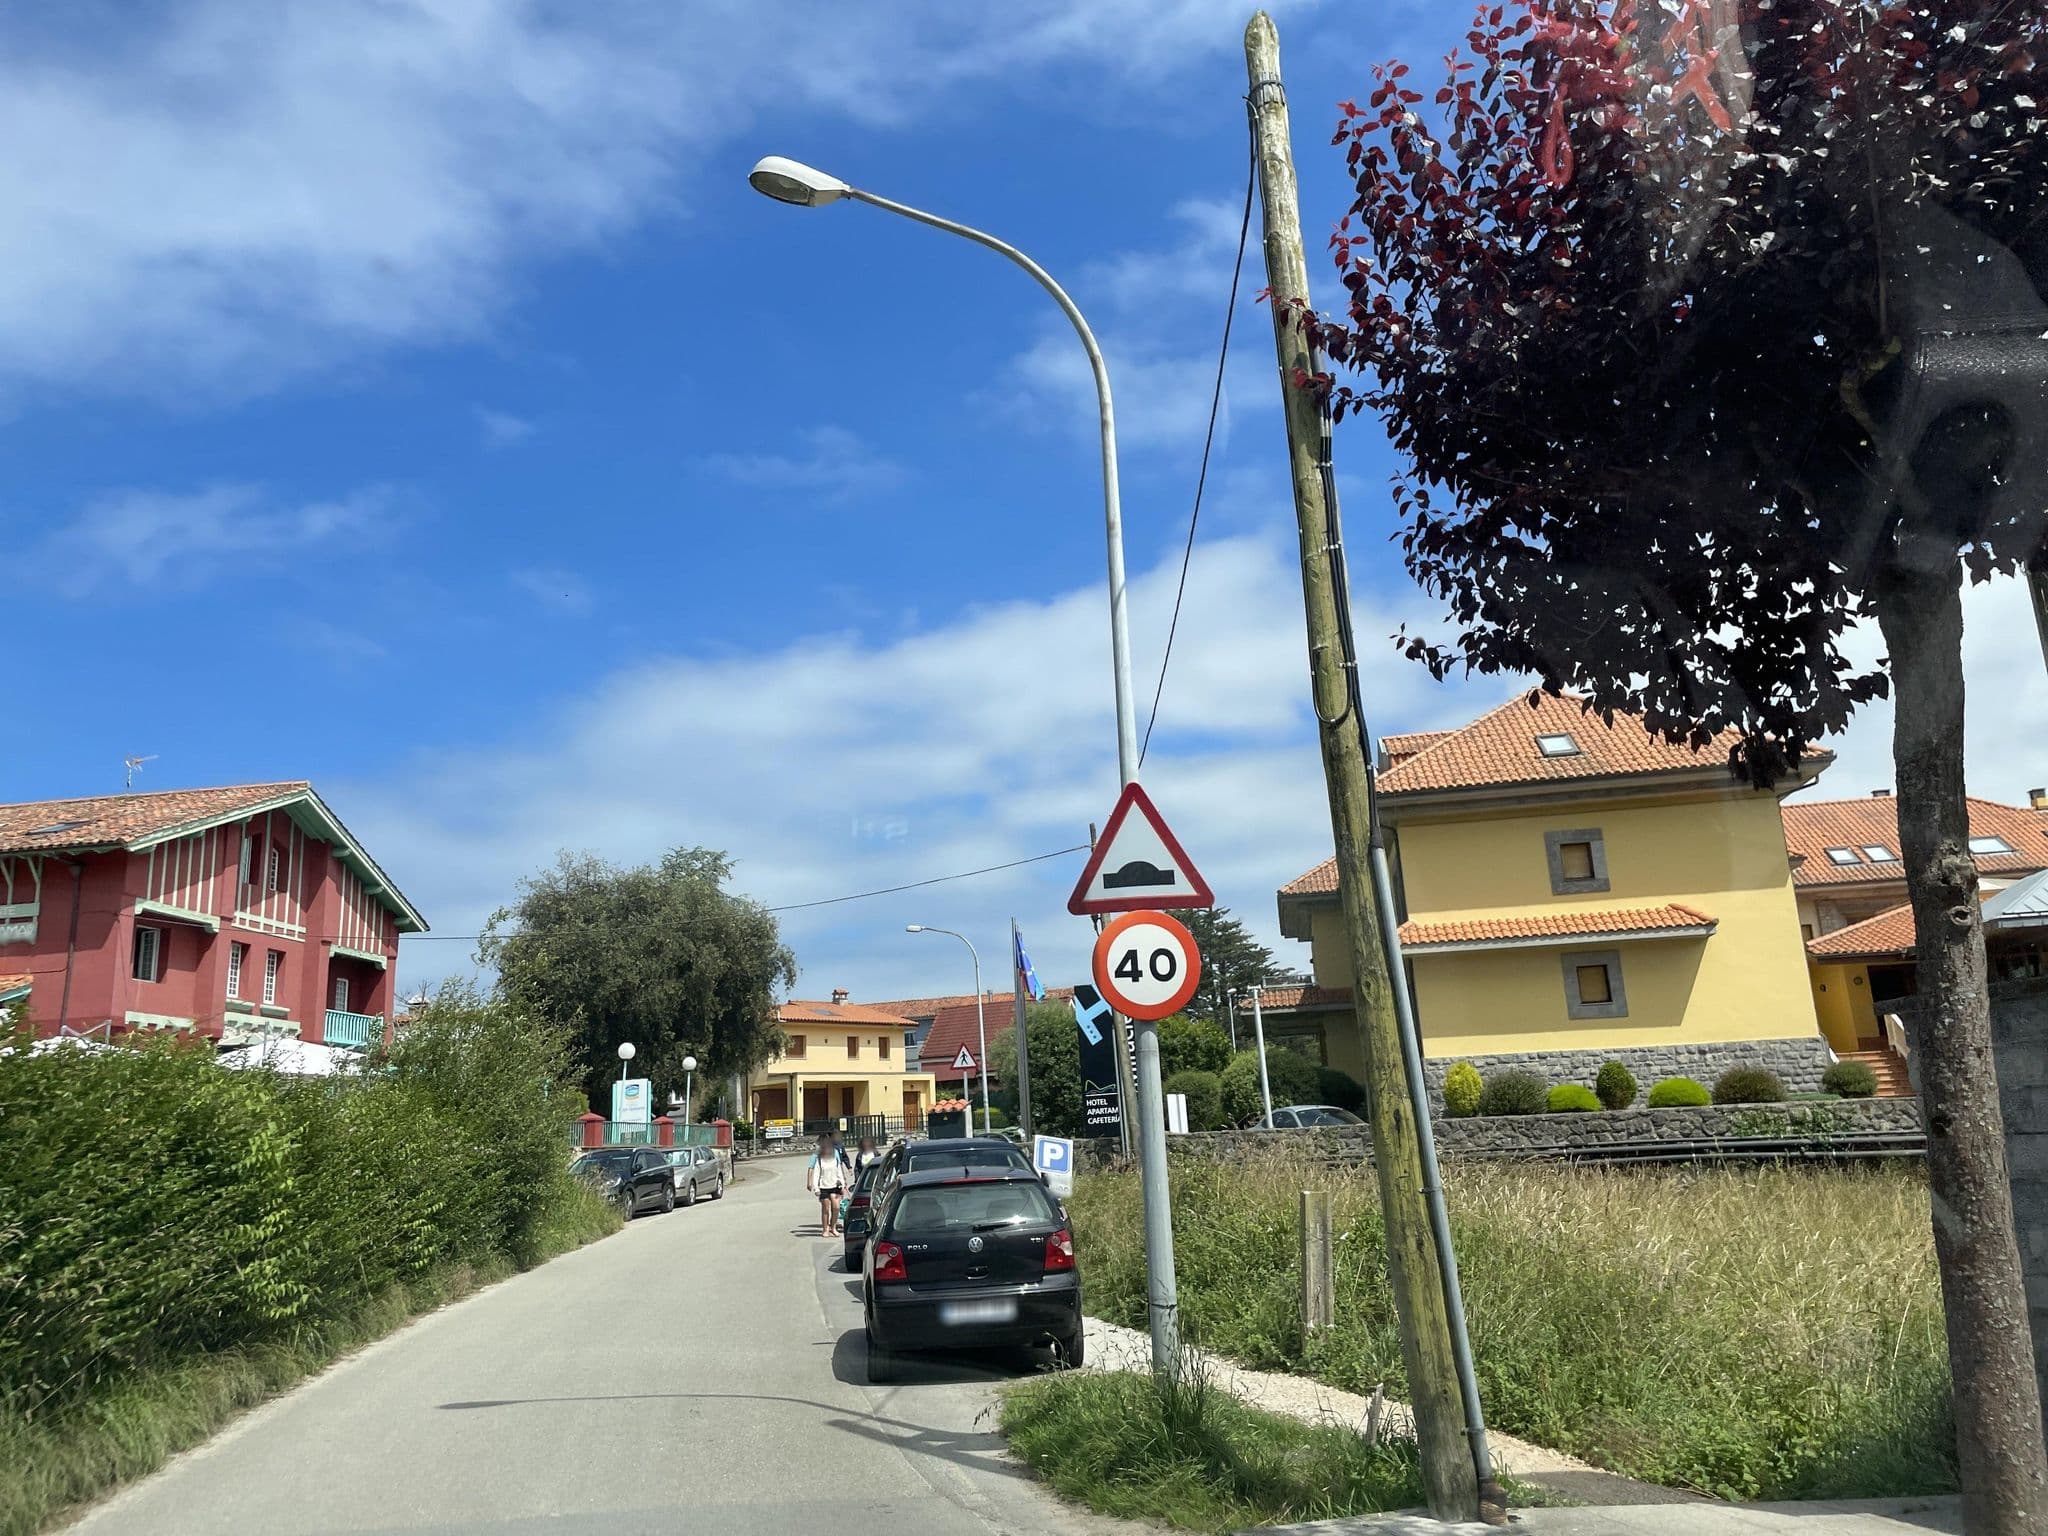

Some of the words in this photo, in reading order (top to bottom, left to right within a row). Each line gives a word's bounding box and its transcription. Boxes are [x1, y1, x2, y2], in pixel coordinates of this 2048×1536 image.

[1115, 948, 1177, 983] 40
[1086, 1098, 1108, 1106] HOTEL
[1087, 1106, 1119, 1116] APARTAM
[1042, 1141, 1064, 1168] P
